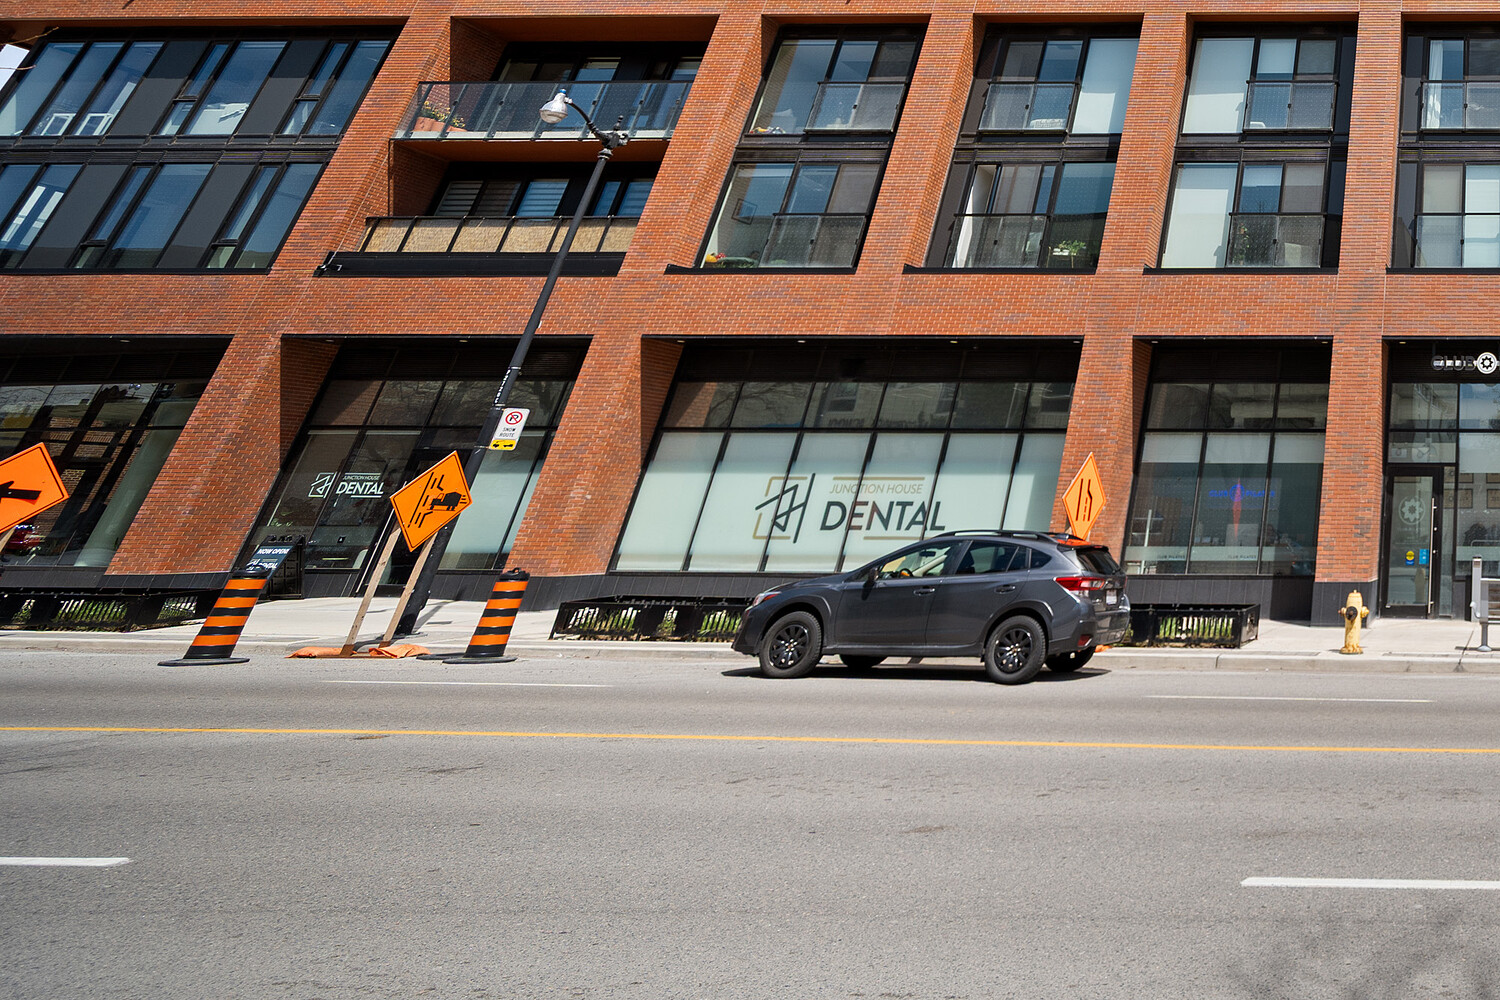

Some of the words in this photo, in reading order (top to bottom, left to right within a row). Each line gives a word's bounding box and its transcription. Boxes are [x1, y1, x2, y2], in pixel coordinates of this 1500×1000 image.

[1431, 356, 1477, 371] CLUB
[336, 482, 384, 494] DENTAL
[829, 483, 882, 494] JUNCTION
[886, 483, 923, 494] HOUSE
[819, 501, 946, 531] DENTAL
